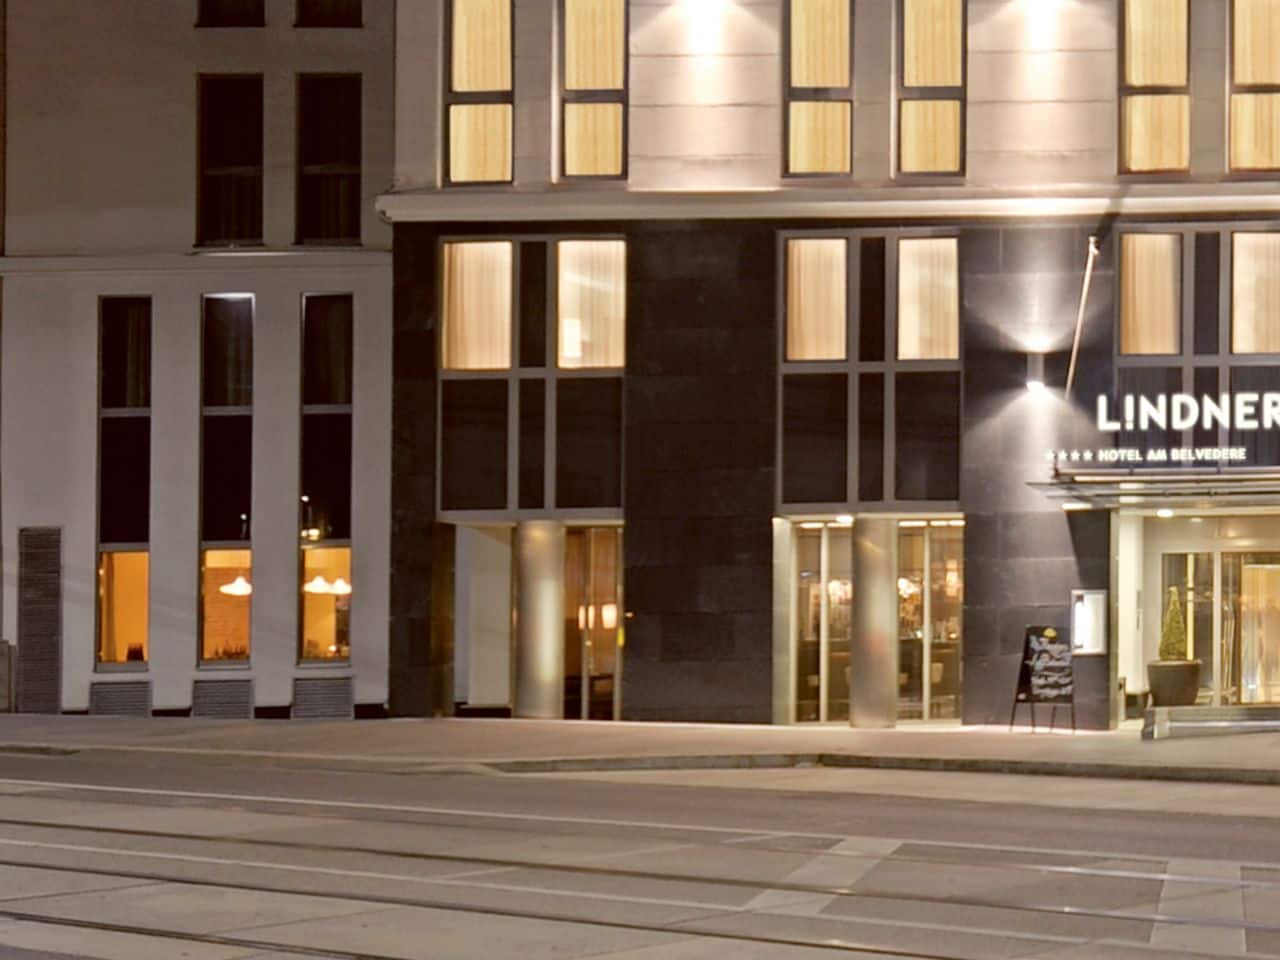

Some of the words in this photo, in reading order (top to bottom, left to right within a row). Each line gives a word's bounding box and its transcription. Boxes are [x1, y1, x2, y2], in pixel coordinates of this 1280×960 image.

[1098, 448, 1143, 462] HOTEL
[1146, 448, 1168, 462] AM
[1170, 447, 1246, 461] BELVEDERE
